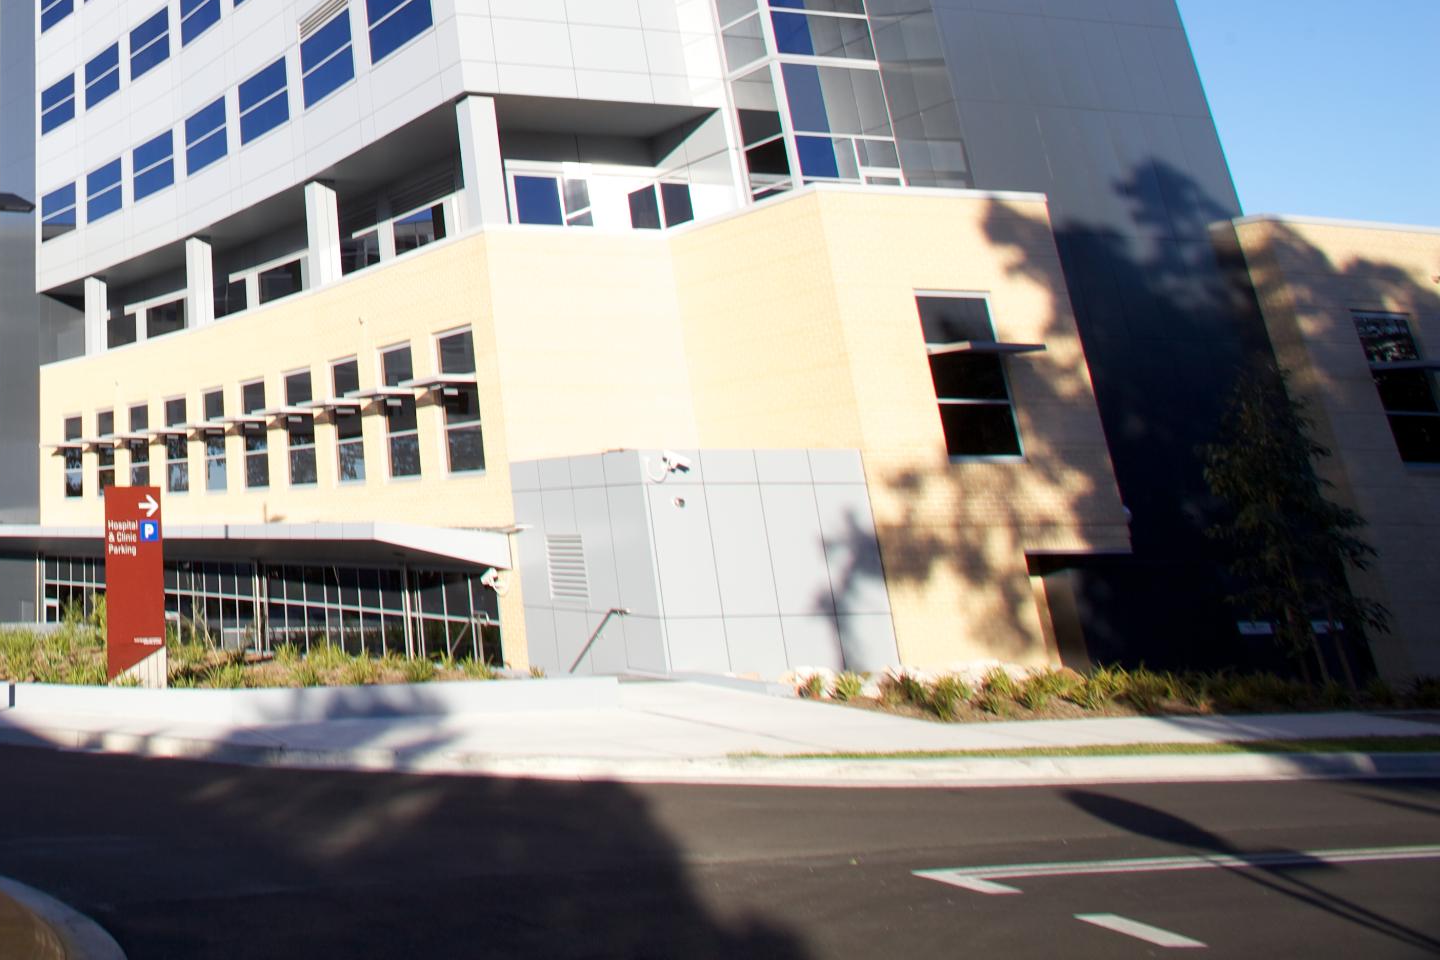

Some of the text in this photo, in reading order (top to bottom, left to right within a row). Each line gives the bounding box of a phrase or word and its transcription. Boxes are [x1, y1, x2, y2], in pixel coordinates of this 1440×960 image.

[107, 519, 138, 532] Hospital
[144, 523, 154, 539] P
[108, 531, 137, 543] & Clinic
[108, 543, 137, 557] Parking
